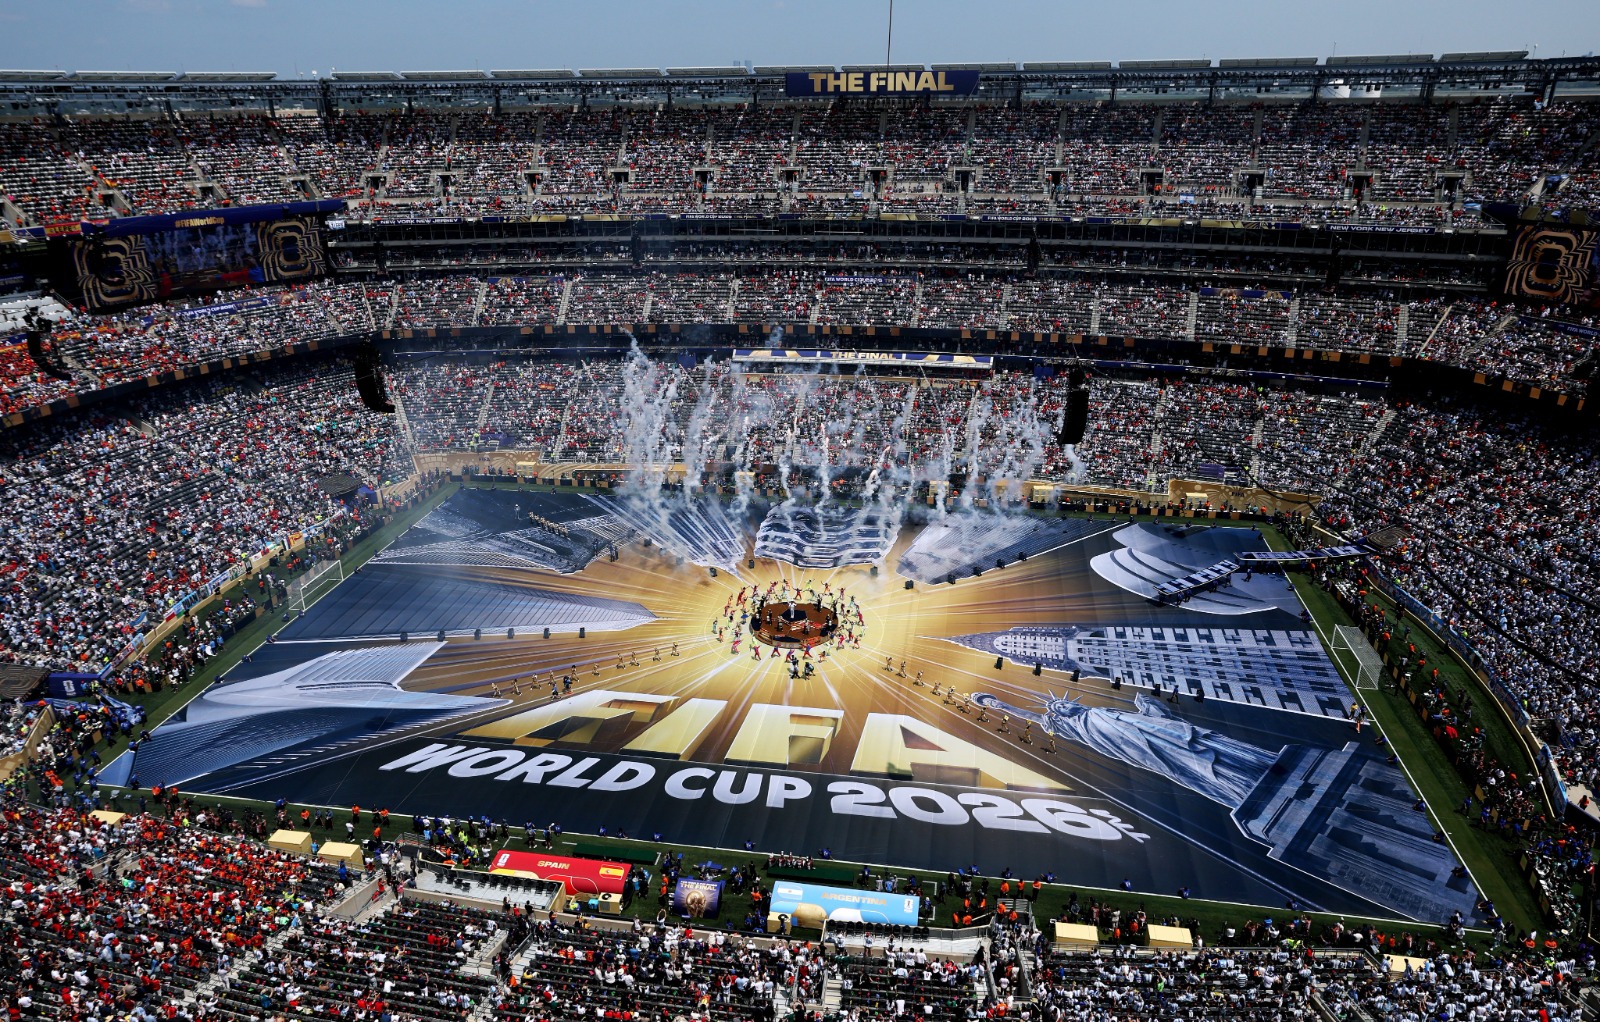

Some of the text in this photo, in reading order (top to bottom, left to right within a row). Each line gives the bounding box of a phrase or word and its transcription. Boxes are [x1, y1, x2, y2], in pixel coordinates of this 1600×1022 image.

[809, 71, 954, 92] THE FINAL
[175, 216, 225, 228] #FIFAWorldCup
[455, 689, 1078, 793] FIFA
[378, 743, 656, 792] WORLD
[664, 766, 813, 809] CUP
[826, 781, 1122, 841] 2026
[537, 860, 571, 870] SPAIN
[821, 891, 887, 905] ARGENTINA
